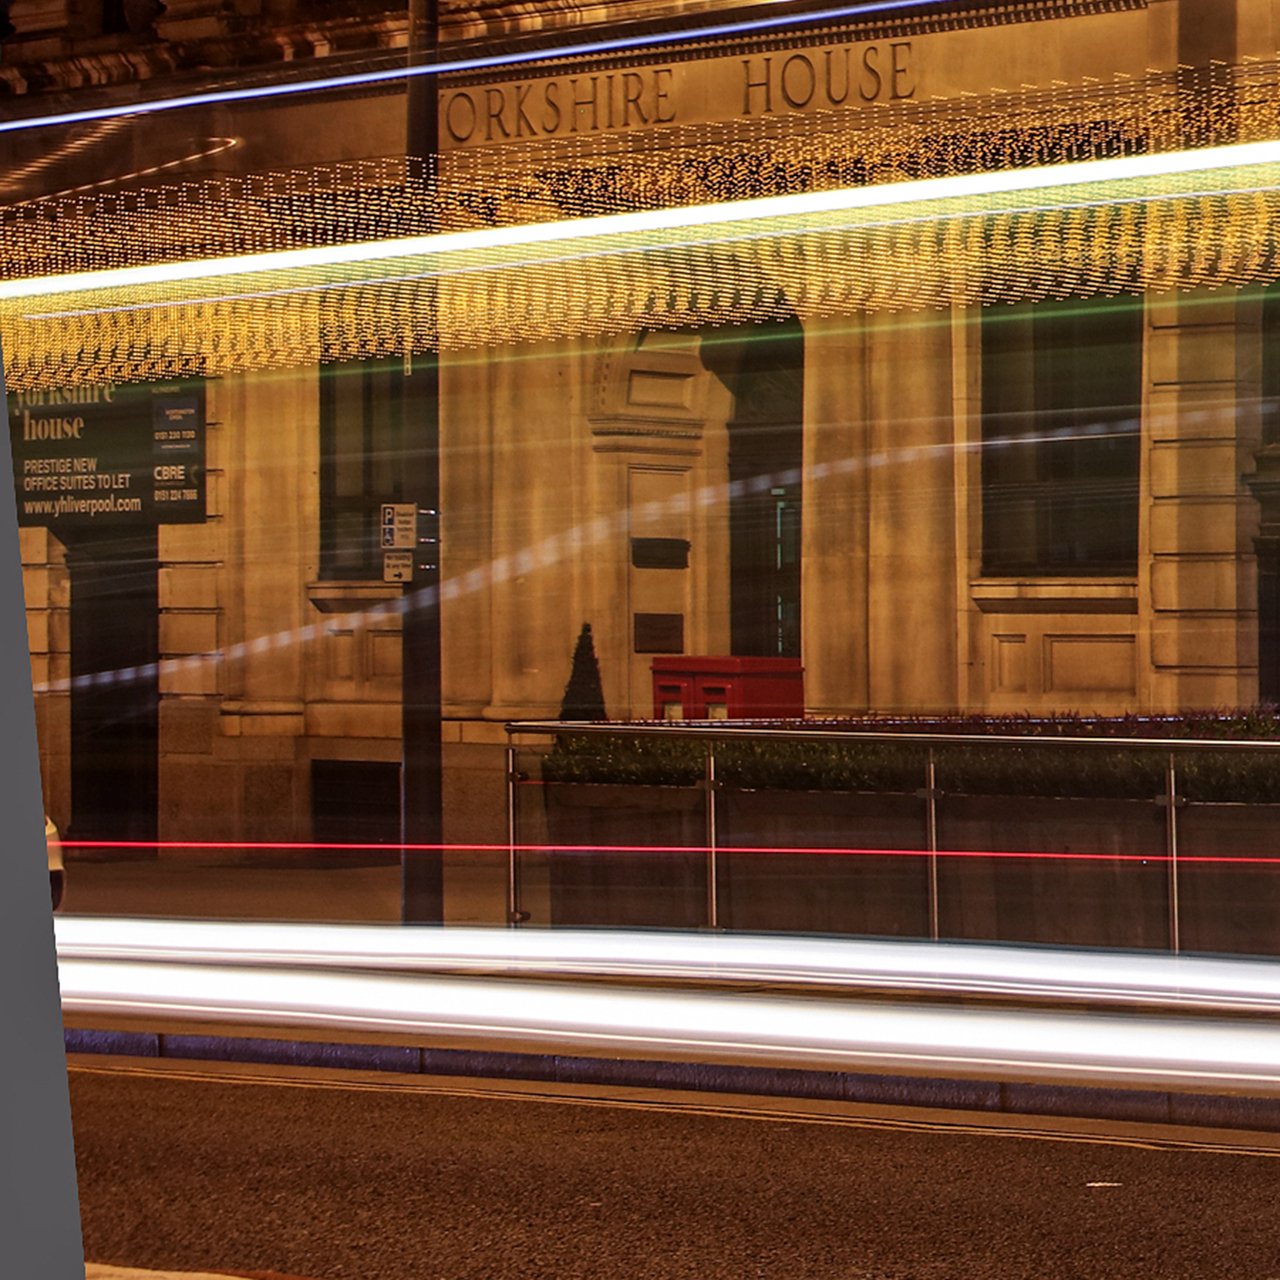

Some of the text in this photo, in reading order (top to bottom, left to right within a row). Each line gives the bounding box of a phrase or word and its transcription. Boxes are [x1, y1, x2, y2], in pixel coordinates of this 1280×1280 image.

[437, 42, 916, 142] ORKSHIRE HOUSE
[23, 409, 85, 441] house
[24, 457, 98, 474] PRESTIGE NEW
[154, 465, 185, 480] CBRE
[24, 473, 131, 492] OFFICE SUITES TO LET
[24, 493, 141, 517] www.yhliverpool.com
